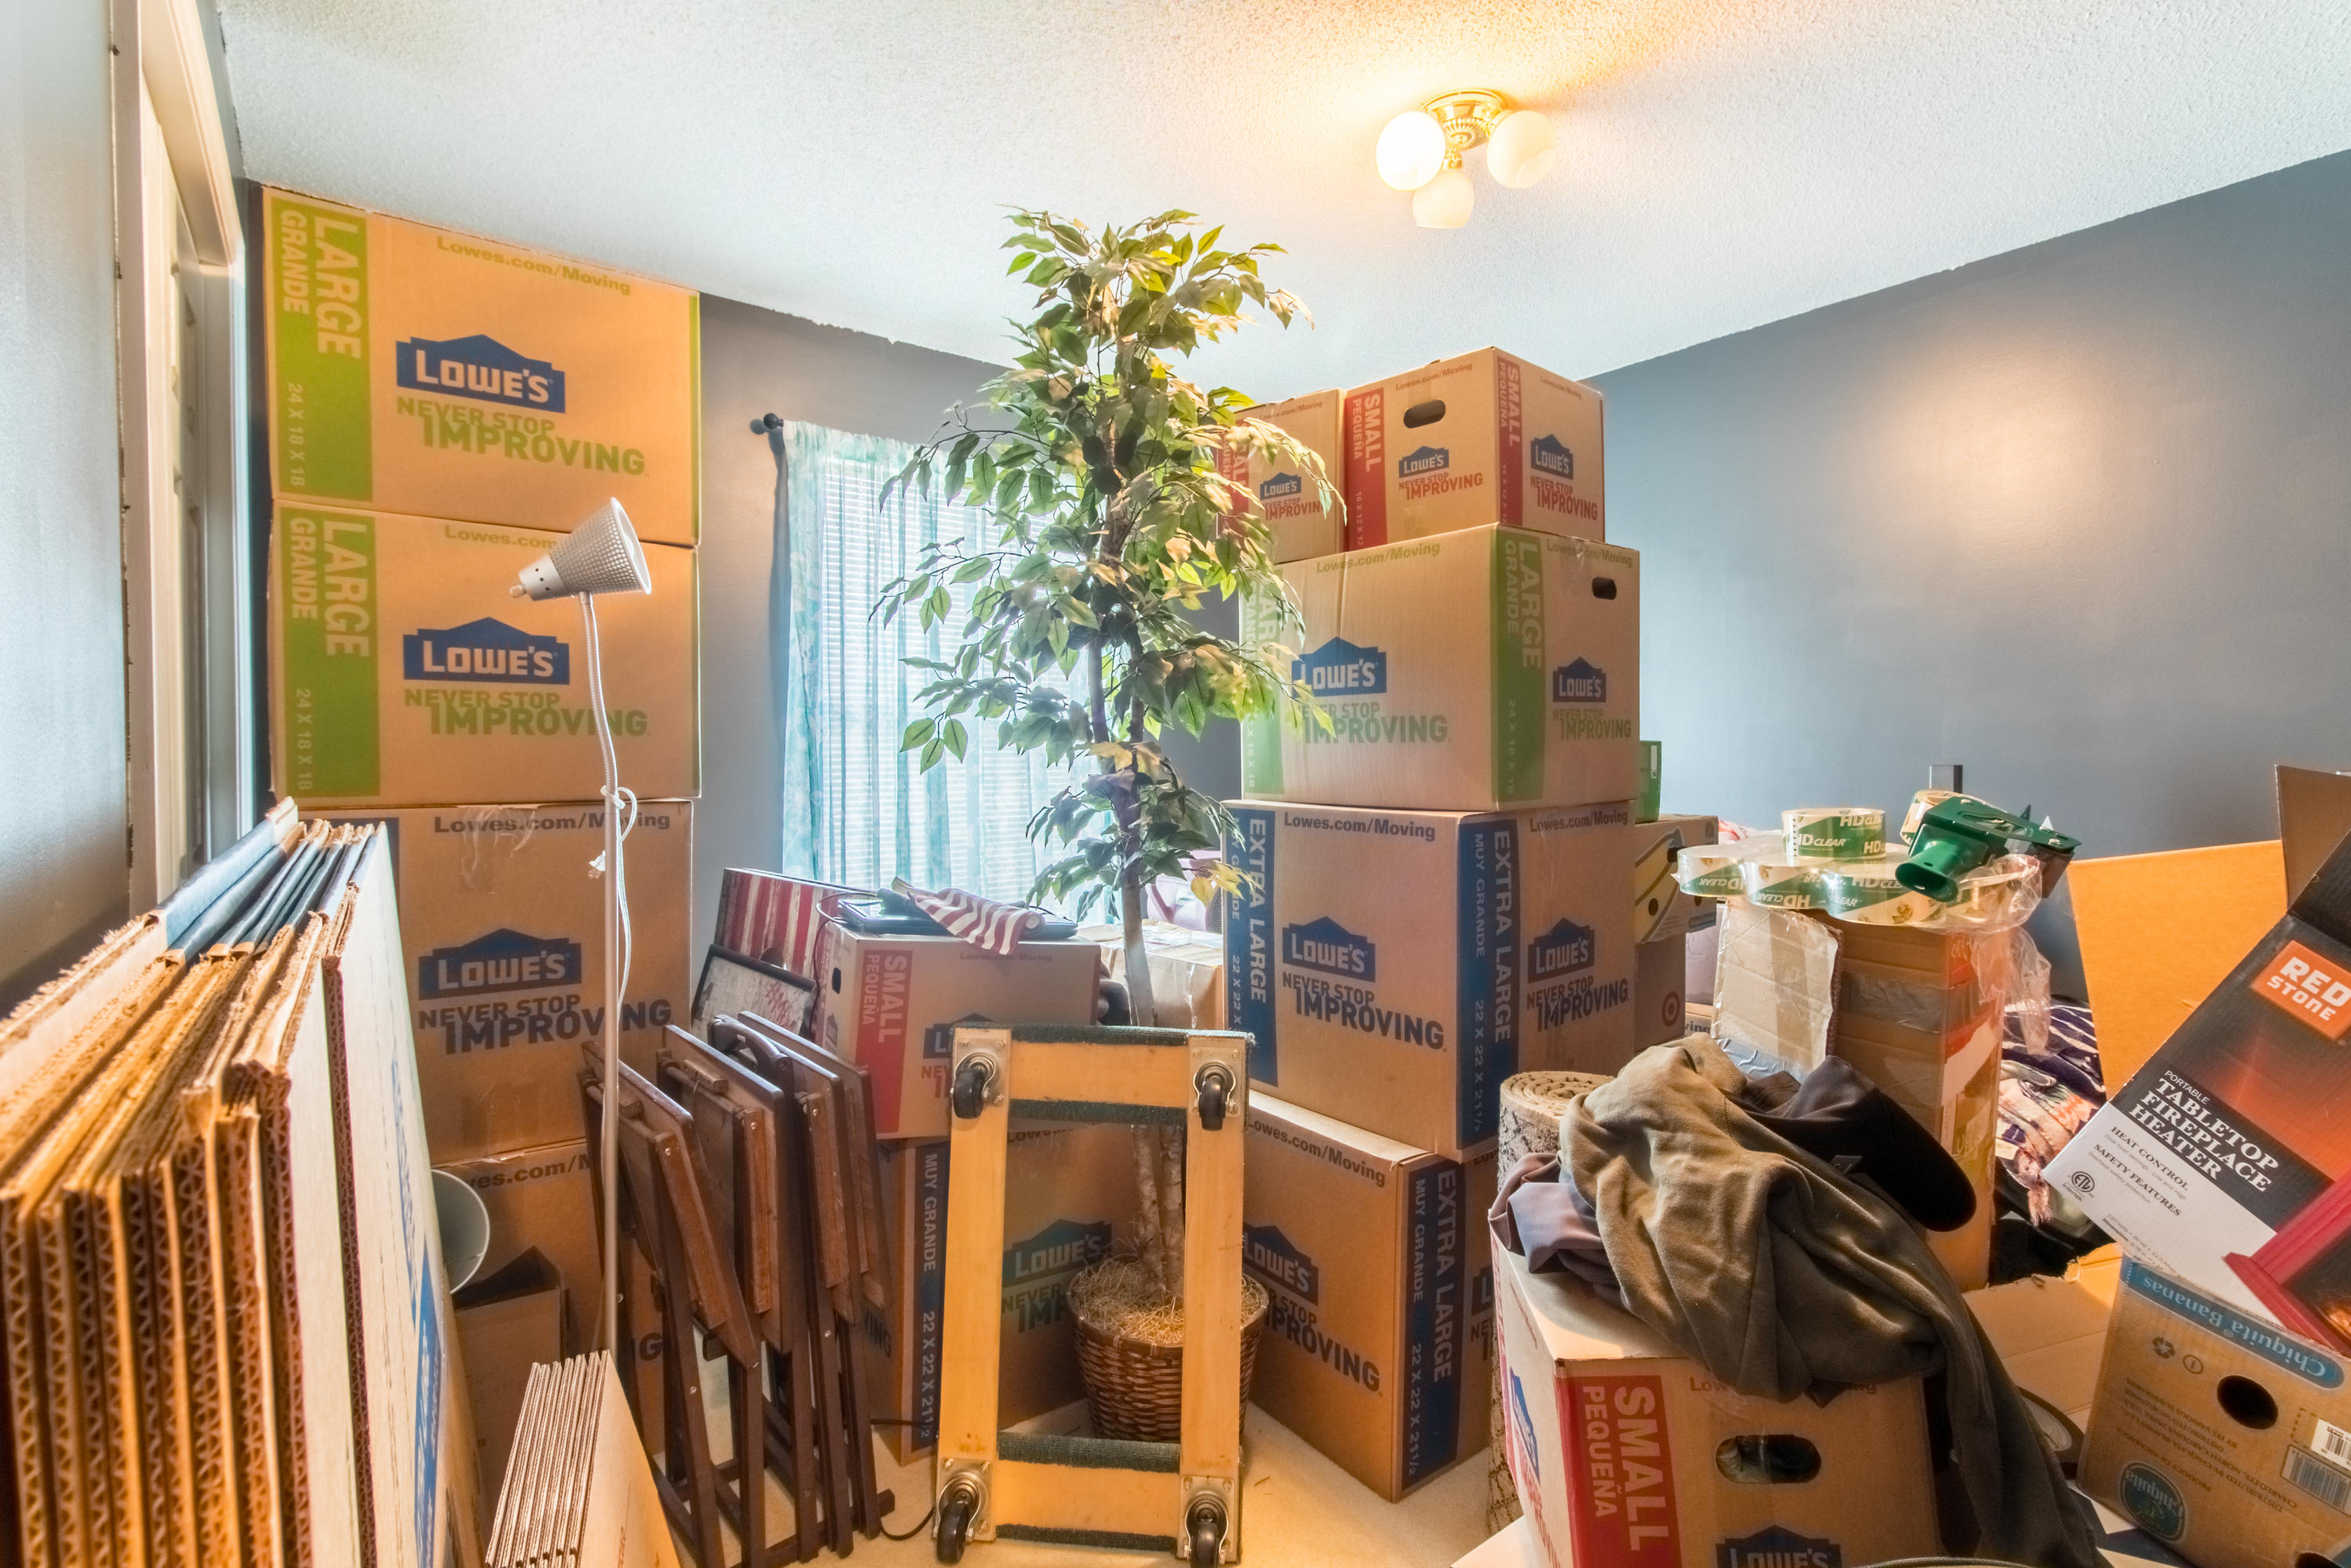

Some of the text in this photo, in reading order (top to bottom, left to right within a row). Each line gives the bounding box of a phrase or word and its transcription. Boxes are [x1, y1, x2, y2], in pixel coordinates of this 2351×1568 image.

[281, 210, 308, 314] GRANDE
[437, 236, 630, 295] Lowes.com/Moving
[313, 215, 361, 358] LARGE
[287, 383, 302, 404] 24
[416, 349, 549, 403] LOWE'S
[1396, 363, 1473, 390] Lowes.com/Moving
[397, 397, 555, 436] NEVER STOP
[1508, 365, 1520, 447] SMALL
[289, 425, 304, 444] 18
[422, 416, 644, 476] IMPROVING
[1353, 398, 1362, 459] PEQUEÑA
[1364, 393, 1381, 473] SMALL
[290, 468, 306, 486] 18
[1404, 454, 1444, 474] LOWE'S
[1535, 444, 1570, 474] LOWE'S
[1264, 480, 1298, 497] LOWE'S
[1399, 473, 1448, 491] NEVER STOP
[1406, 473, 1483, 501] IMPROVING
[1531, 475, 1573, 495] NEVER STOP
[1266, 500, 1321, 520] IMPROVIN
[1283, 498, 1301, 507] STOP
[1537, 487, 1598, 520] IMPROVING
[289, 517, 317, 619] GRANDE
[1317, 543, 1440, 574] Lowes.com/Moving
[323, 520, 369, 656] LARGE
[1505, 539, 1519, 635] GRANDE
[1518, 541, 1542, 669] LARGE
[424, 640, 553, 677] LOWE'S
[296, 689, 310, 708] 24
[404, 689, 560, 709] NEVER STOP
[1559, 673, 1602, 697] LOWE'S
[429, 706, 647, 736] IMPROVNG
[1342, 702, 1380, 718] STOP
[1552, 708, 1603, 722] NEVER STOP
[298, 731, 311, 750] 18
[1304, 715, 1448, 744] IMPROVING
[1560, 719, 1632, 741] IMPROVING
[298, 772, 312, 790] 18
[1284, 812, 1436, 842] Lowes.com/Moving
[1530, 810, 1628, 833] Lowes.com/Moving
[1249, 819, 1266, 1003] EXTRA LARGE
[1475, 834, 1485, 958] MUY GRANDE
[1784, 894, 1810, 909] HD
[1291, 937, 1365, 973] LOWE'S
[1494, 831, 1512, 1043] EXTRA LARGE
[438, 951, 566, 990] LOWE'S
[1536, 937, 1589, 975] LOWE'S
[862, 954, 880, 1026] PEQUEÑA
[878, 954, 907, 1044] SMALL
[1282, 972, 1375, 1009] NEVER STOP
[1527, 975, 1594, 1010] NEVER STOP
[2267, 975, 2337, 1022] STONE
[2279, 956, 2351, 1008] RED
[418, 994, 581, 1029] NEVER STOP
[1295, 986, 1444, 1050] IMPROVING
[1475, 1000, 1484, 1021] 22
[1537, 978, 1628, 1033] IMPROVING
[445, 999, 672, 1056] IMPROVNG
[1474, 1045, 1483, 1066] 22
[2164, 1070, 2210, 1105] PORTABLE
[2129, 1103, 2222, 1179] HEATER
[2140, 1091, 2272, 1192] FIREPLACE
[2156, 1078, 2279, 1170] TABLETOP
[2110, 1127, 2188, 1190] HEAT CONTROL
[2094, 1144, 2182, 1215] SAFETY FEATURES
[923, 1153, 938, 1272] MUY GRANDE
[1016, 1233, 1102, 1278] LOWE'S
[1413, 1178, 1425, 1302] MUY GRANDE
[1433, 1171, 1456, 1383] EXTRA LARGE
[923, 1312, 935, 1329] 22
[1281, 1295, 1317, 1326] STOP
[2143, 1276, 2326, 1377] Chiquita Bananas
[922, 1355, 934, 1373] 22
[1265, 1307, 1379, 1392] PROVING
[1411, 1344, 1422, 1366] 22
[1411, 1388, 1422, 1409] 22
[1582, 1385, 1617, 1518] PEQUEÑA
[1614, 1387, 1670, 1551] SMALL
[2126, 1469, 2184, 1518] Chiquita
